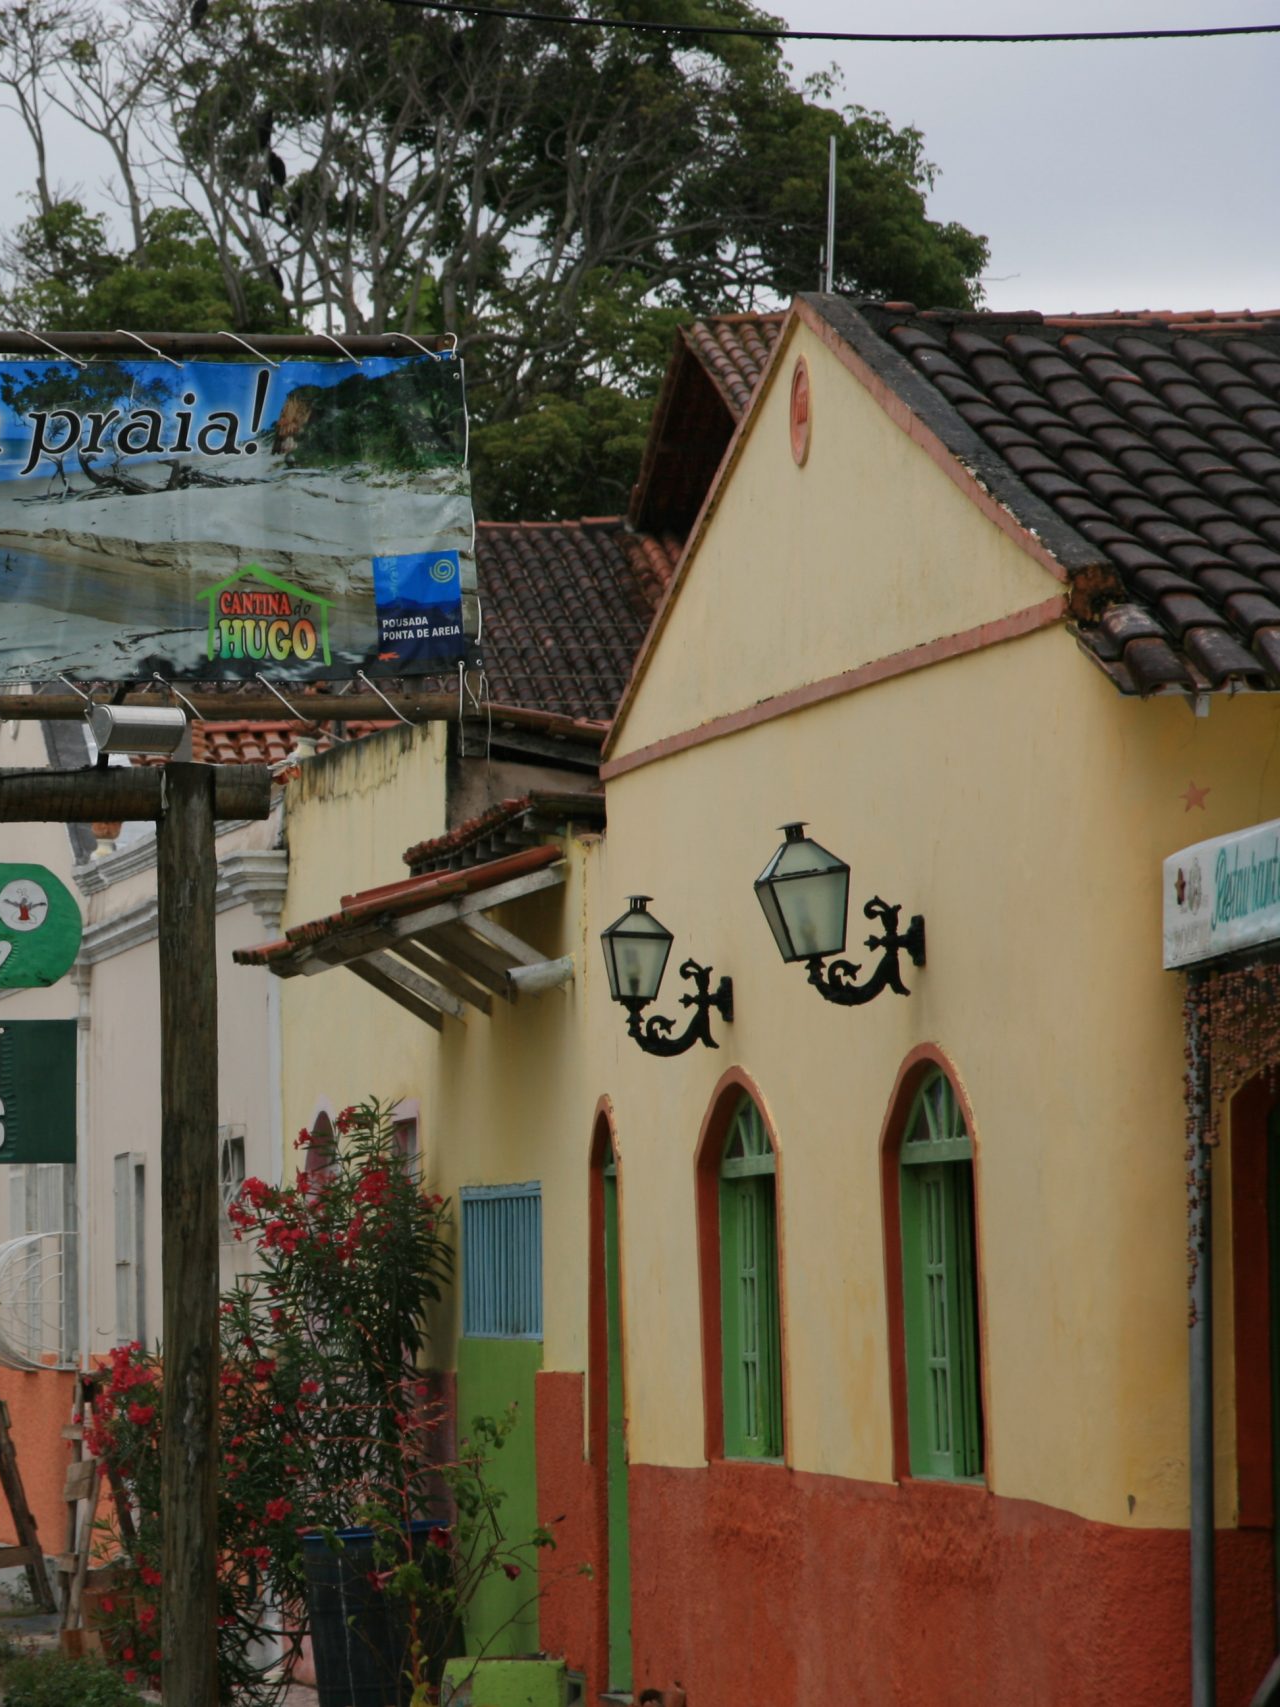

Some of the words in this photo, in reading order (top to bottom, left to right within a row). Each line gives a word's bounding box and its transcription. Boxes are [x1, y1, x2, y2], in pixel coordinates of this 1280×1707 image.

[21, 369, 270, 474] praia!
[220, 592, 291, 616] CANTINA
[293, 599, 311, 616] do
[382, 616, 429, 628] POUSADA
[382, 629, 415, 641] PONTA
[417, 628, 430, 638] DE
[432, 625, 461, 636] AREIA
[220, 619, 317, 660] HUGO
